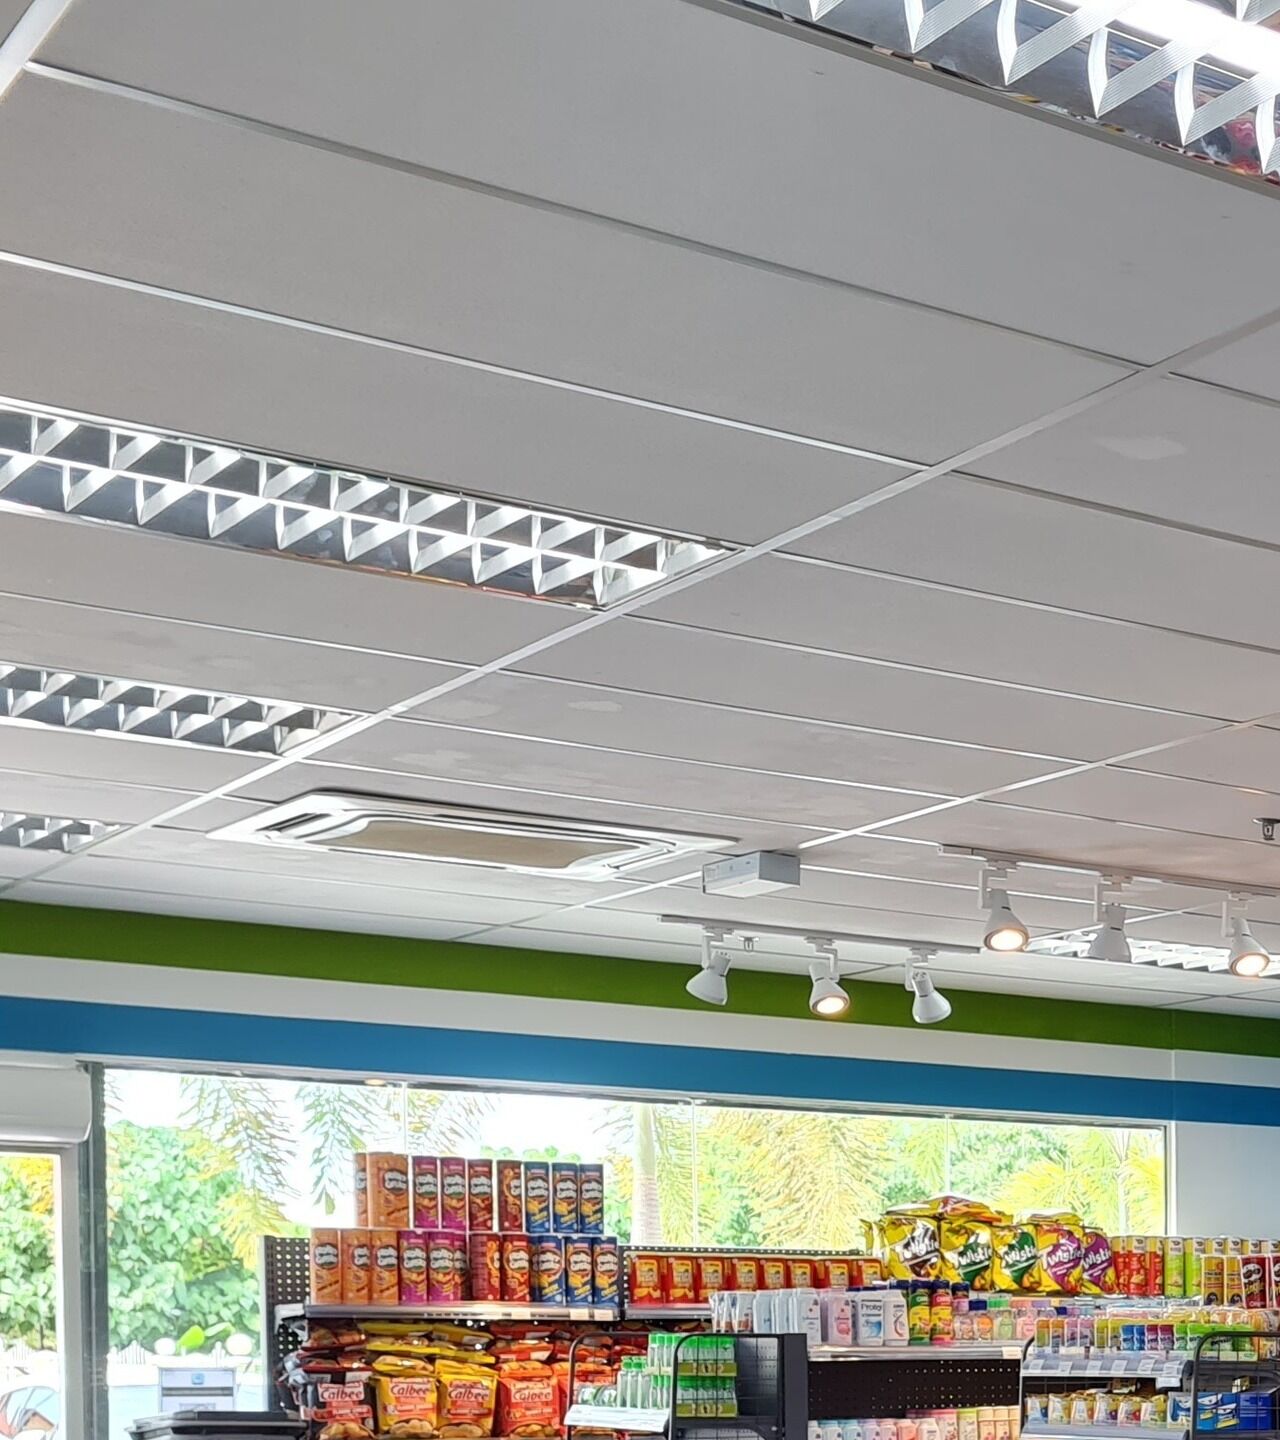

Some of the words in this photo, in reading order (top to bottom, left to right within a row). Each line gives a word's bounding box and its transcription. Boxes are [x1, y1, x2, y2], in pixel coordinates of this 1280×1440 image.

[320, 1387, 362, 1400] Calbee
[390, 1385, 430, 1396] Calbee
[448, 1388, 489, 1400] Calbee
